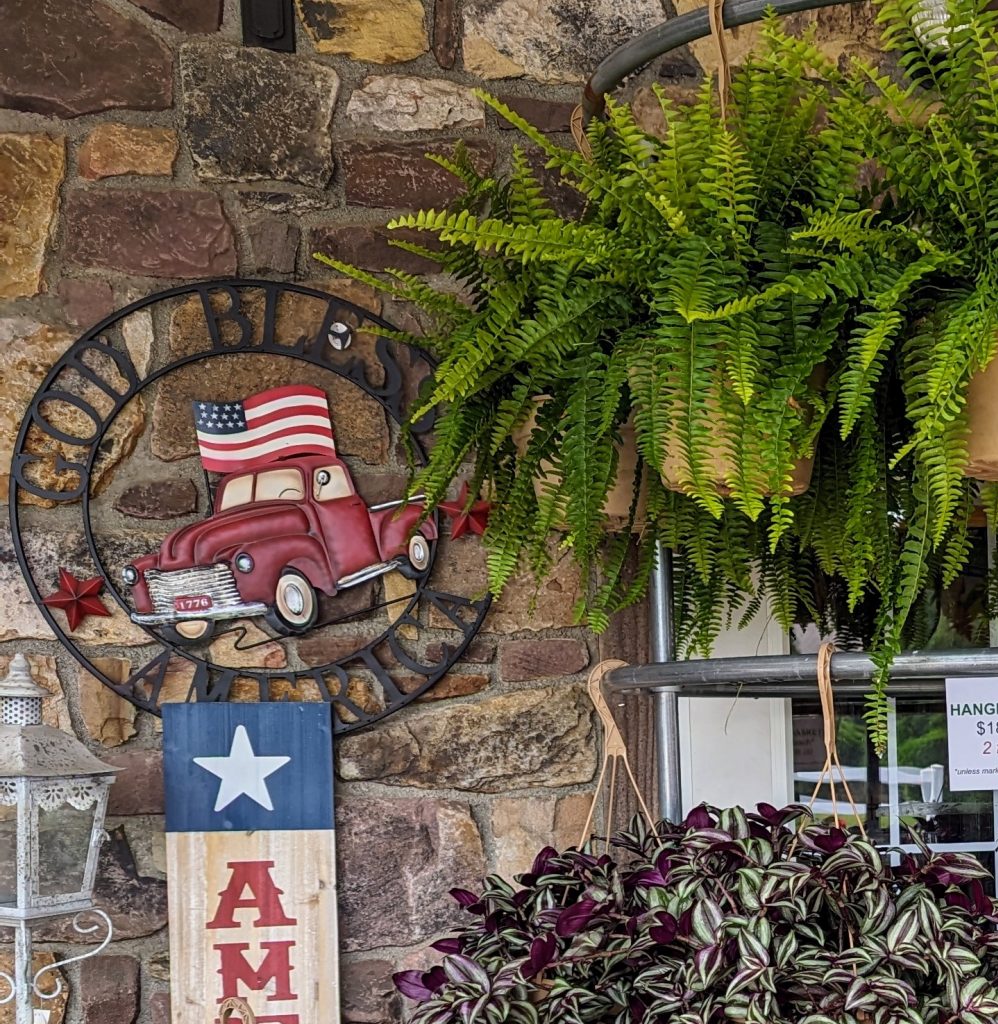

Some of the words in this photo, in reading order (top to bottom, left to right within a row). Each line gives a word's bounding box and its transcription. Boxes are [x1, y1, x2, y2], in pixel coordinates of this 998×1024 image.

[15, 339, 138, 499] GOD
[179, 598, 209, 610] 1776
[983, 741, 992, 754] 2
